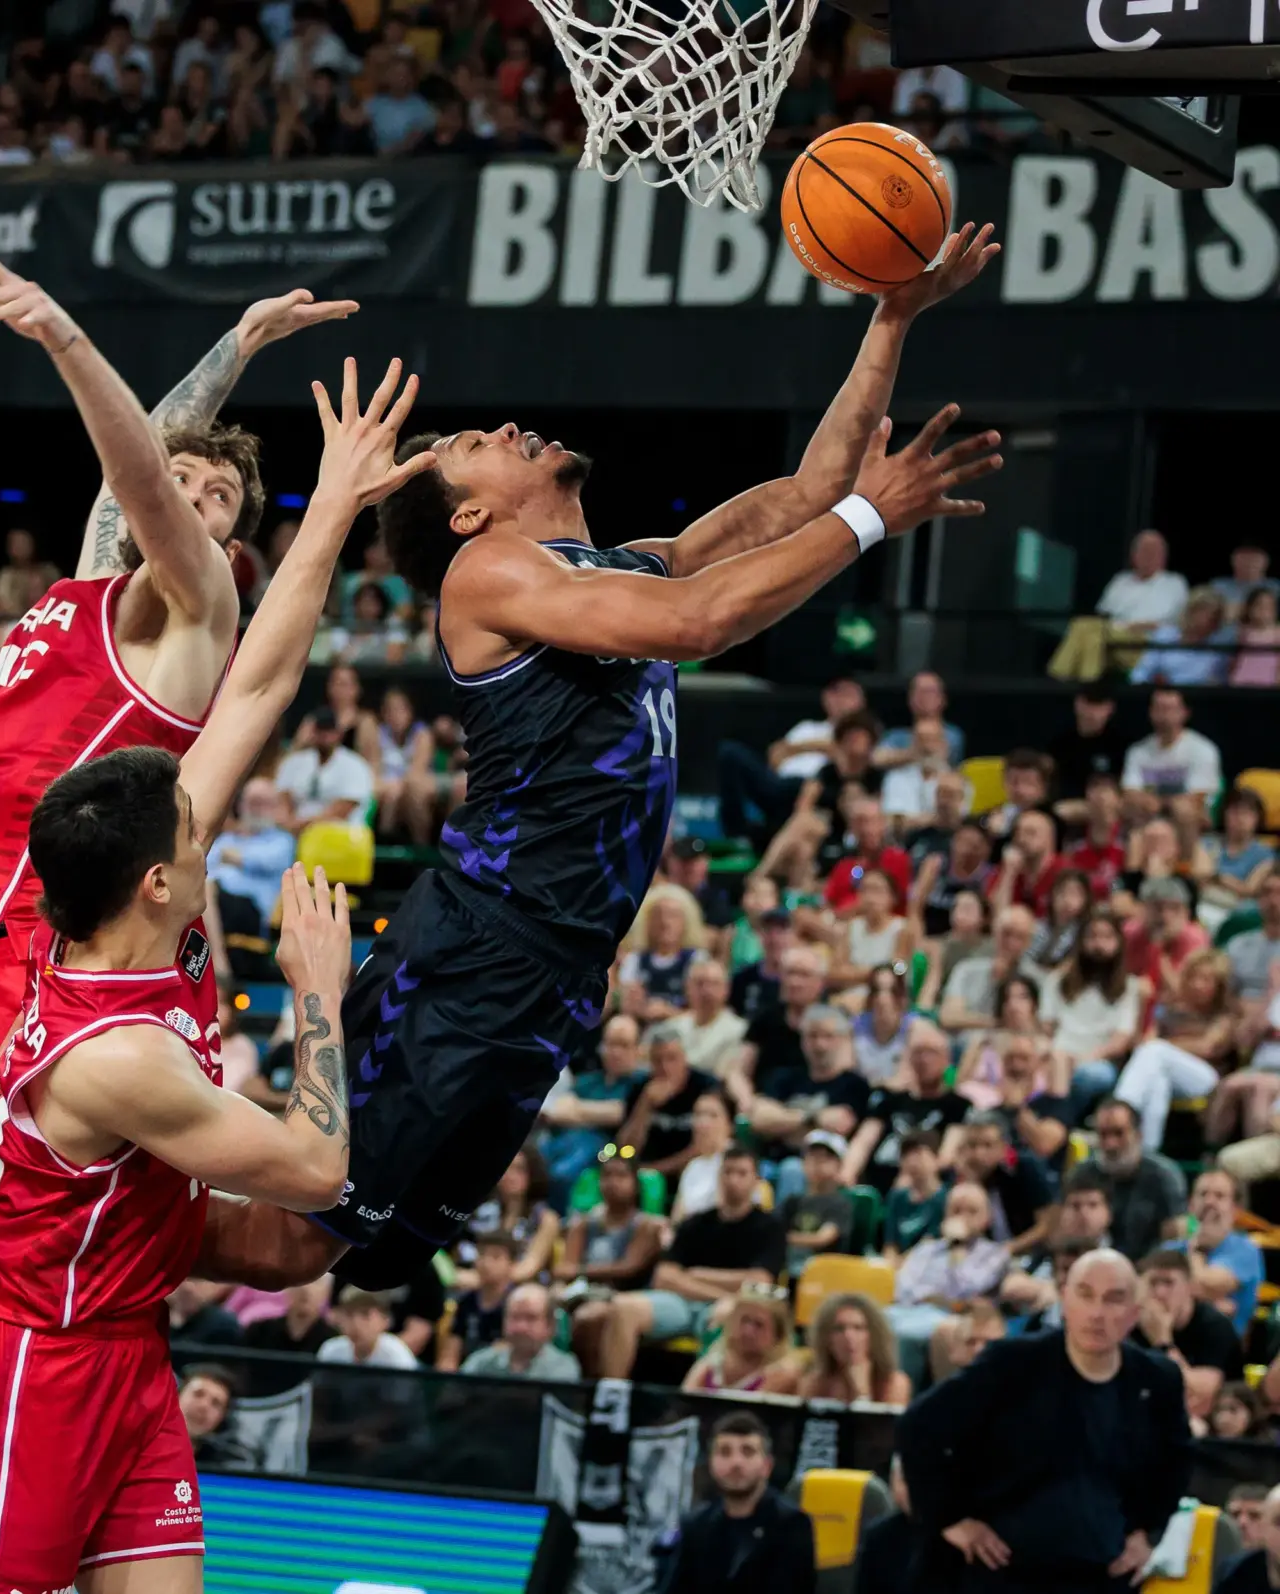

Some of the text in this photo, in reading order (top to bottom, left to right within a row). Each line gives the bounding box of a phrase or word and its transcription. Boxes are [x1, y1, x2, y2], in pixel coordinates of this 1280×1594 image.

[189, 178, 396, 237] surne
[641, 687, 677, 759] 19
[186, 954, 197, 973] liga
[193, 942, 208, 977] endesa
[182, 1016, 194, 1037] IRONA
[155, 1517, 184, 1527] Pirineu
[184, 1515, 193, 1523] de
[164, 1507, 187, 1516] Costa
